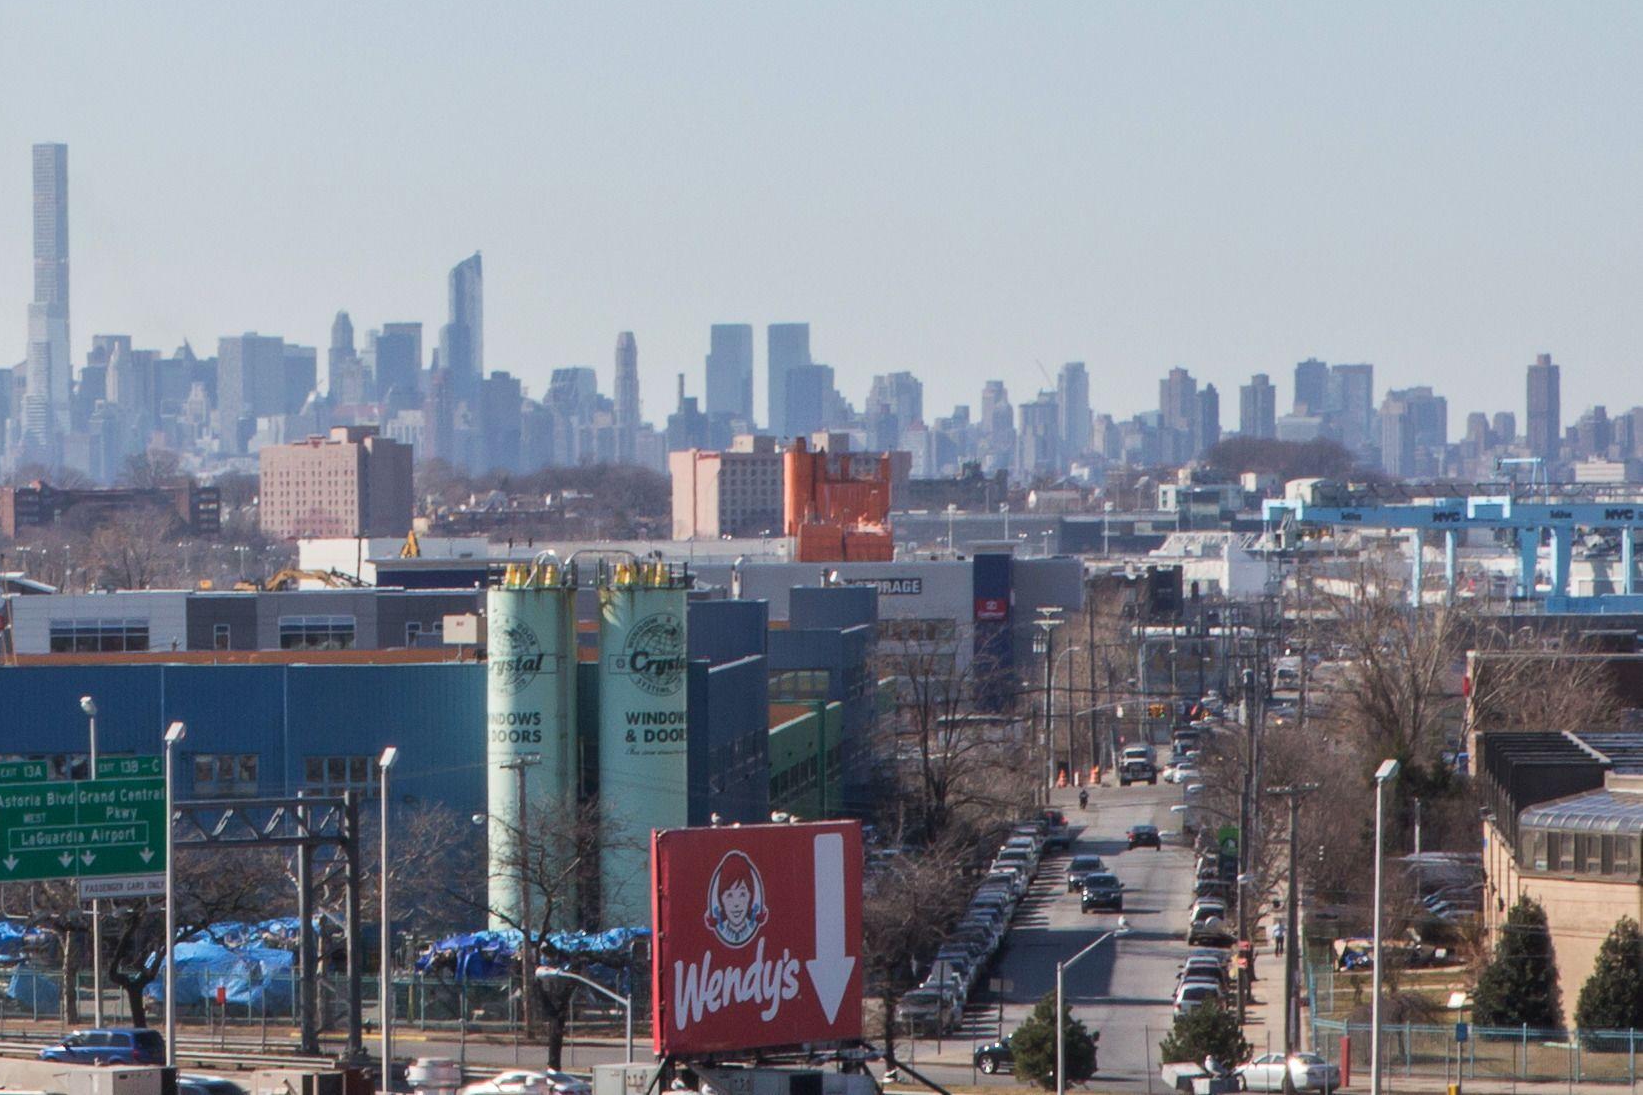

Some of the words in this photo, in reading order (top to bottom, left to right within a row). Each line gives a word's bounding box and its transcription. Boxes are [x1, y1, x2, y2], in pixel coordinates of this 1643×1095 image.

[624, 729, 637, 743] &
[23, 765, 43, 778] 13A
[120, 760, 139, 773] 13B
[46, 792, 75, 805] Blvd
[79, 790, 116, 804] Grand
[23, 812, 47, 824] WEST
[106, 806, 138, 822] Pkwy
[21, 831, 85, 846] LaGuardia
[91, 827, 136, 844] Airport
[674, 936, 800, 1032] Wendy's
